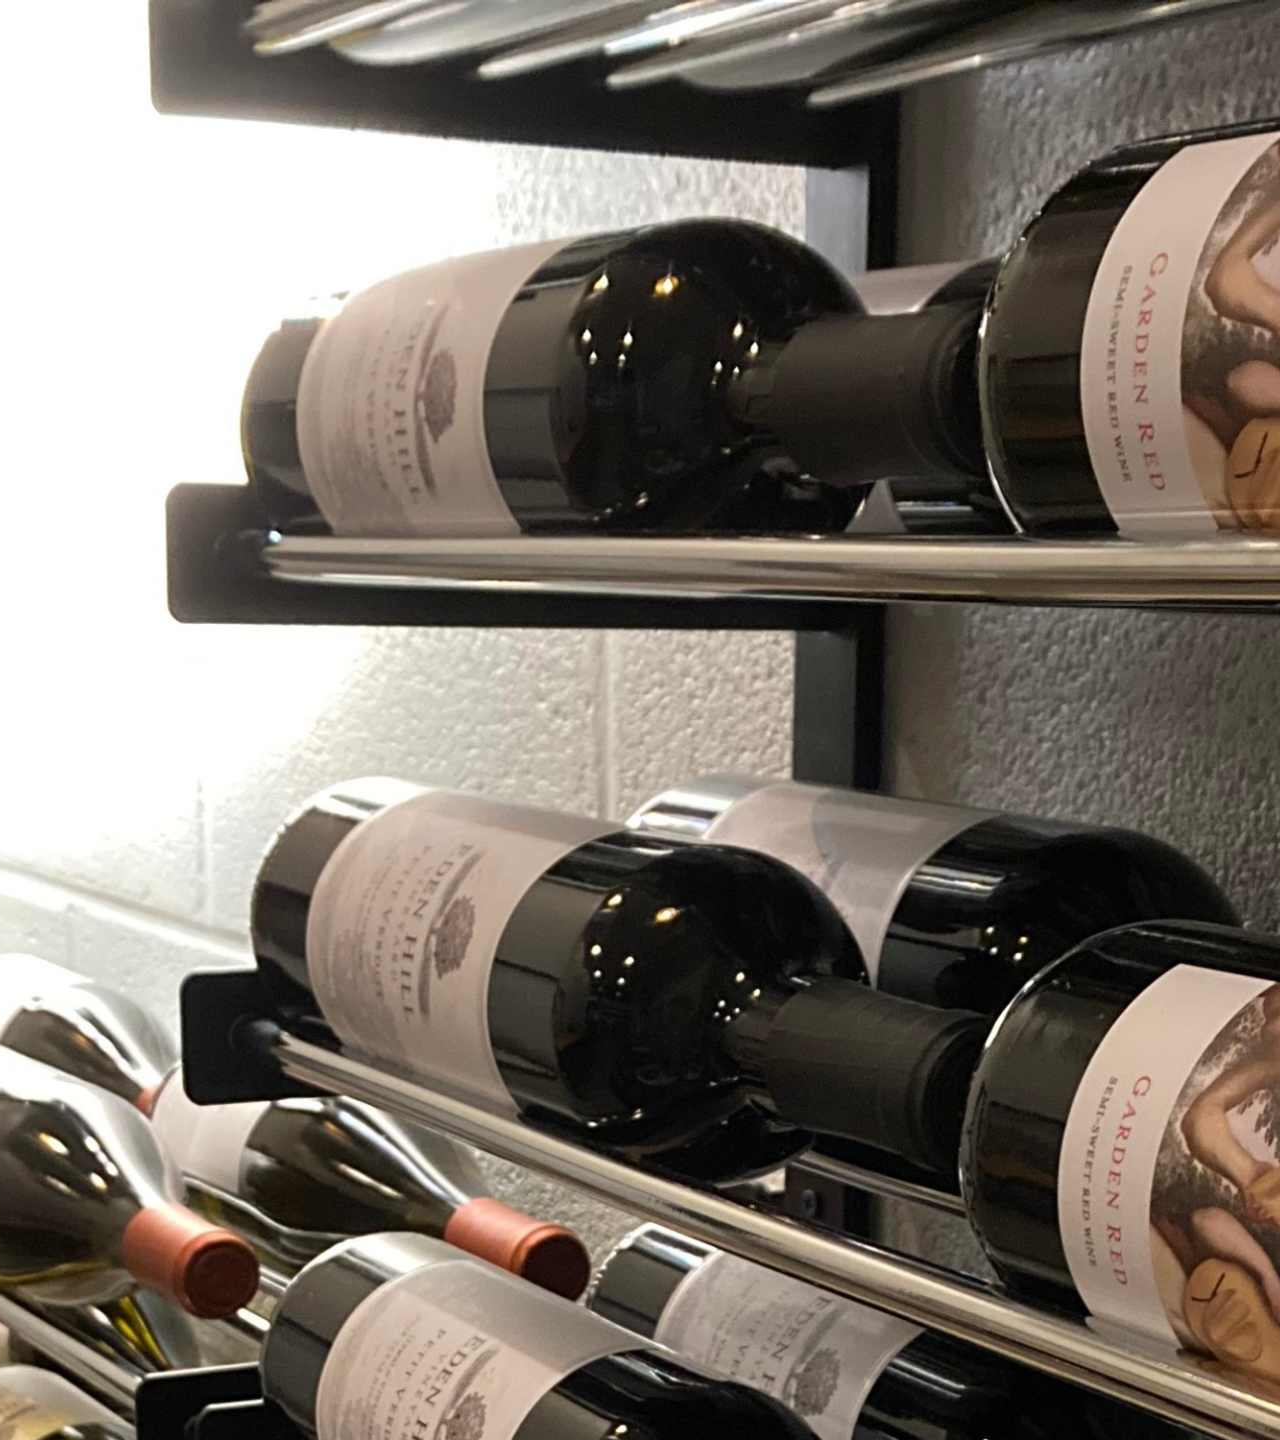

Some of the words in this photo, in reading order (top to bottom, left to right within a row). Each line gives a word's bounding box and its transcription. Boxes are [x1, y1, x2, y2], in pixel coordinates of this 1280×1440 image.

[1105, 265, 1132, 386] SEMI-SWEET
[1133, 251, 1169, 406] GARDEN
[1105, 393, 1119, 429] RED
[1113, 430, 1132, 483] WINE
[1137, 422, 1167, 491] RED
[1081, 1075, 1118, 1188] SEMI-SWEET
[1106, 1074, 1152, 1210] GARDEN
[1078, 1189, 1092, 1225] RED
[1078, 1226, 1097, 1268] WINE
[1104, 1225, 1128, 1287] RED
[424, 1334, 486, 1407] EDEN
